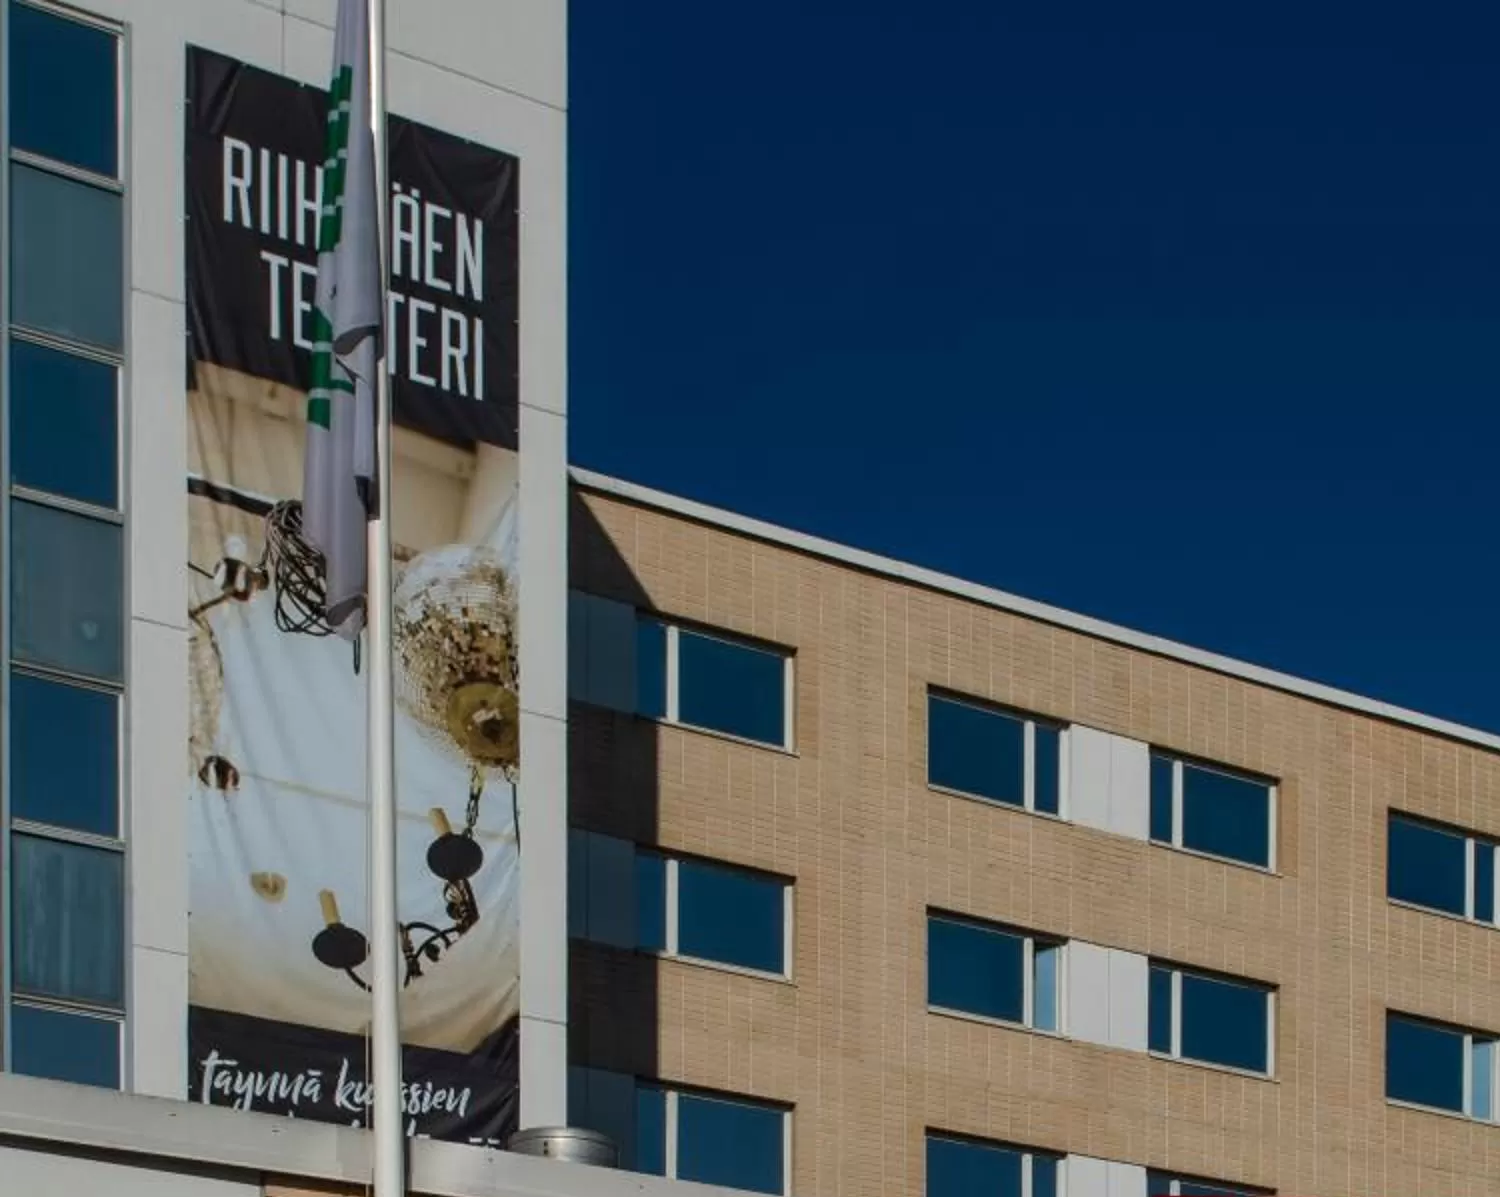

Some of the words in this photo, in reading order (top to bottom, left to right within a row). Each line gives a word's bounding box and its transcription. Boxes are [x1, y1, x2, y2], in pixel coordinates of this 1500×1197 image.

[222, 134, 484, 302] RIIHÄEN
[259, 249, 484, 400] TETERI
[335, 1057, 471, 1118] kusien
